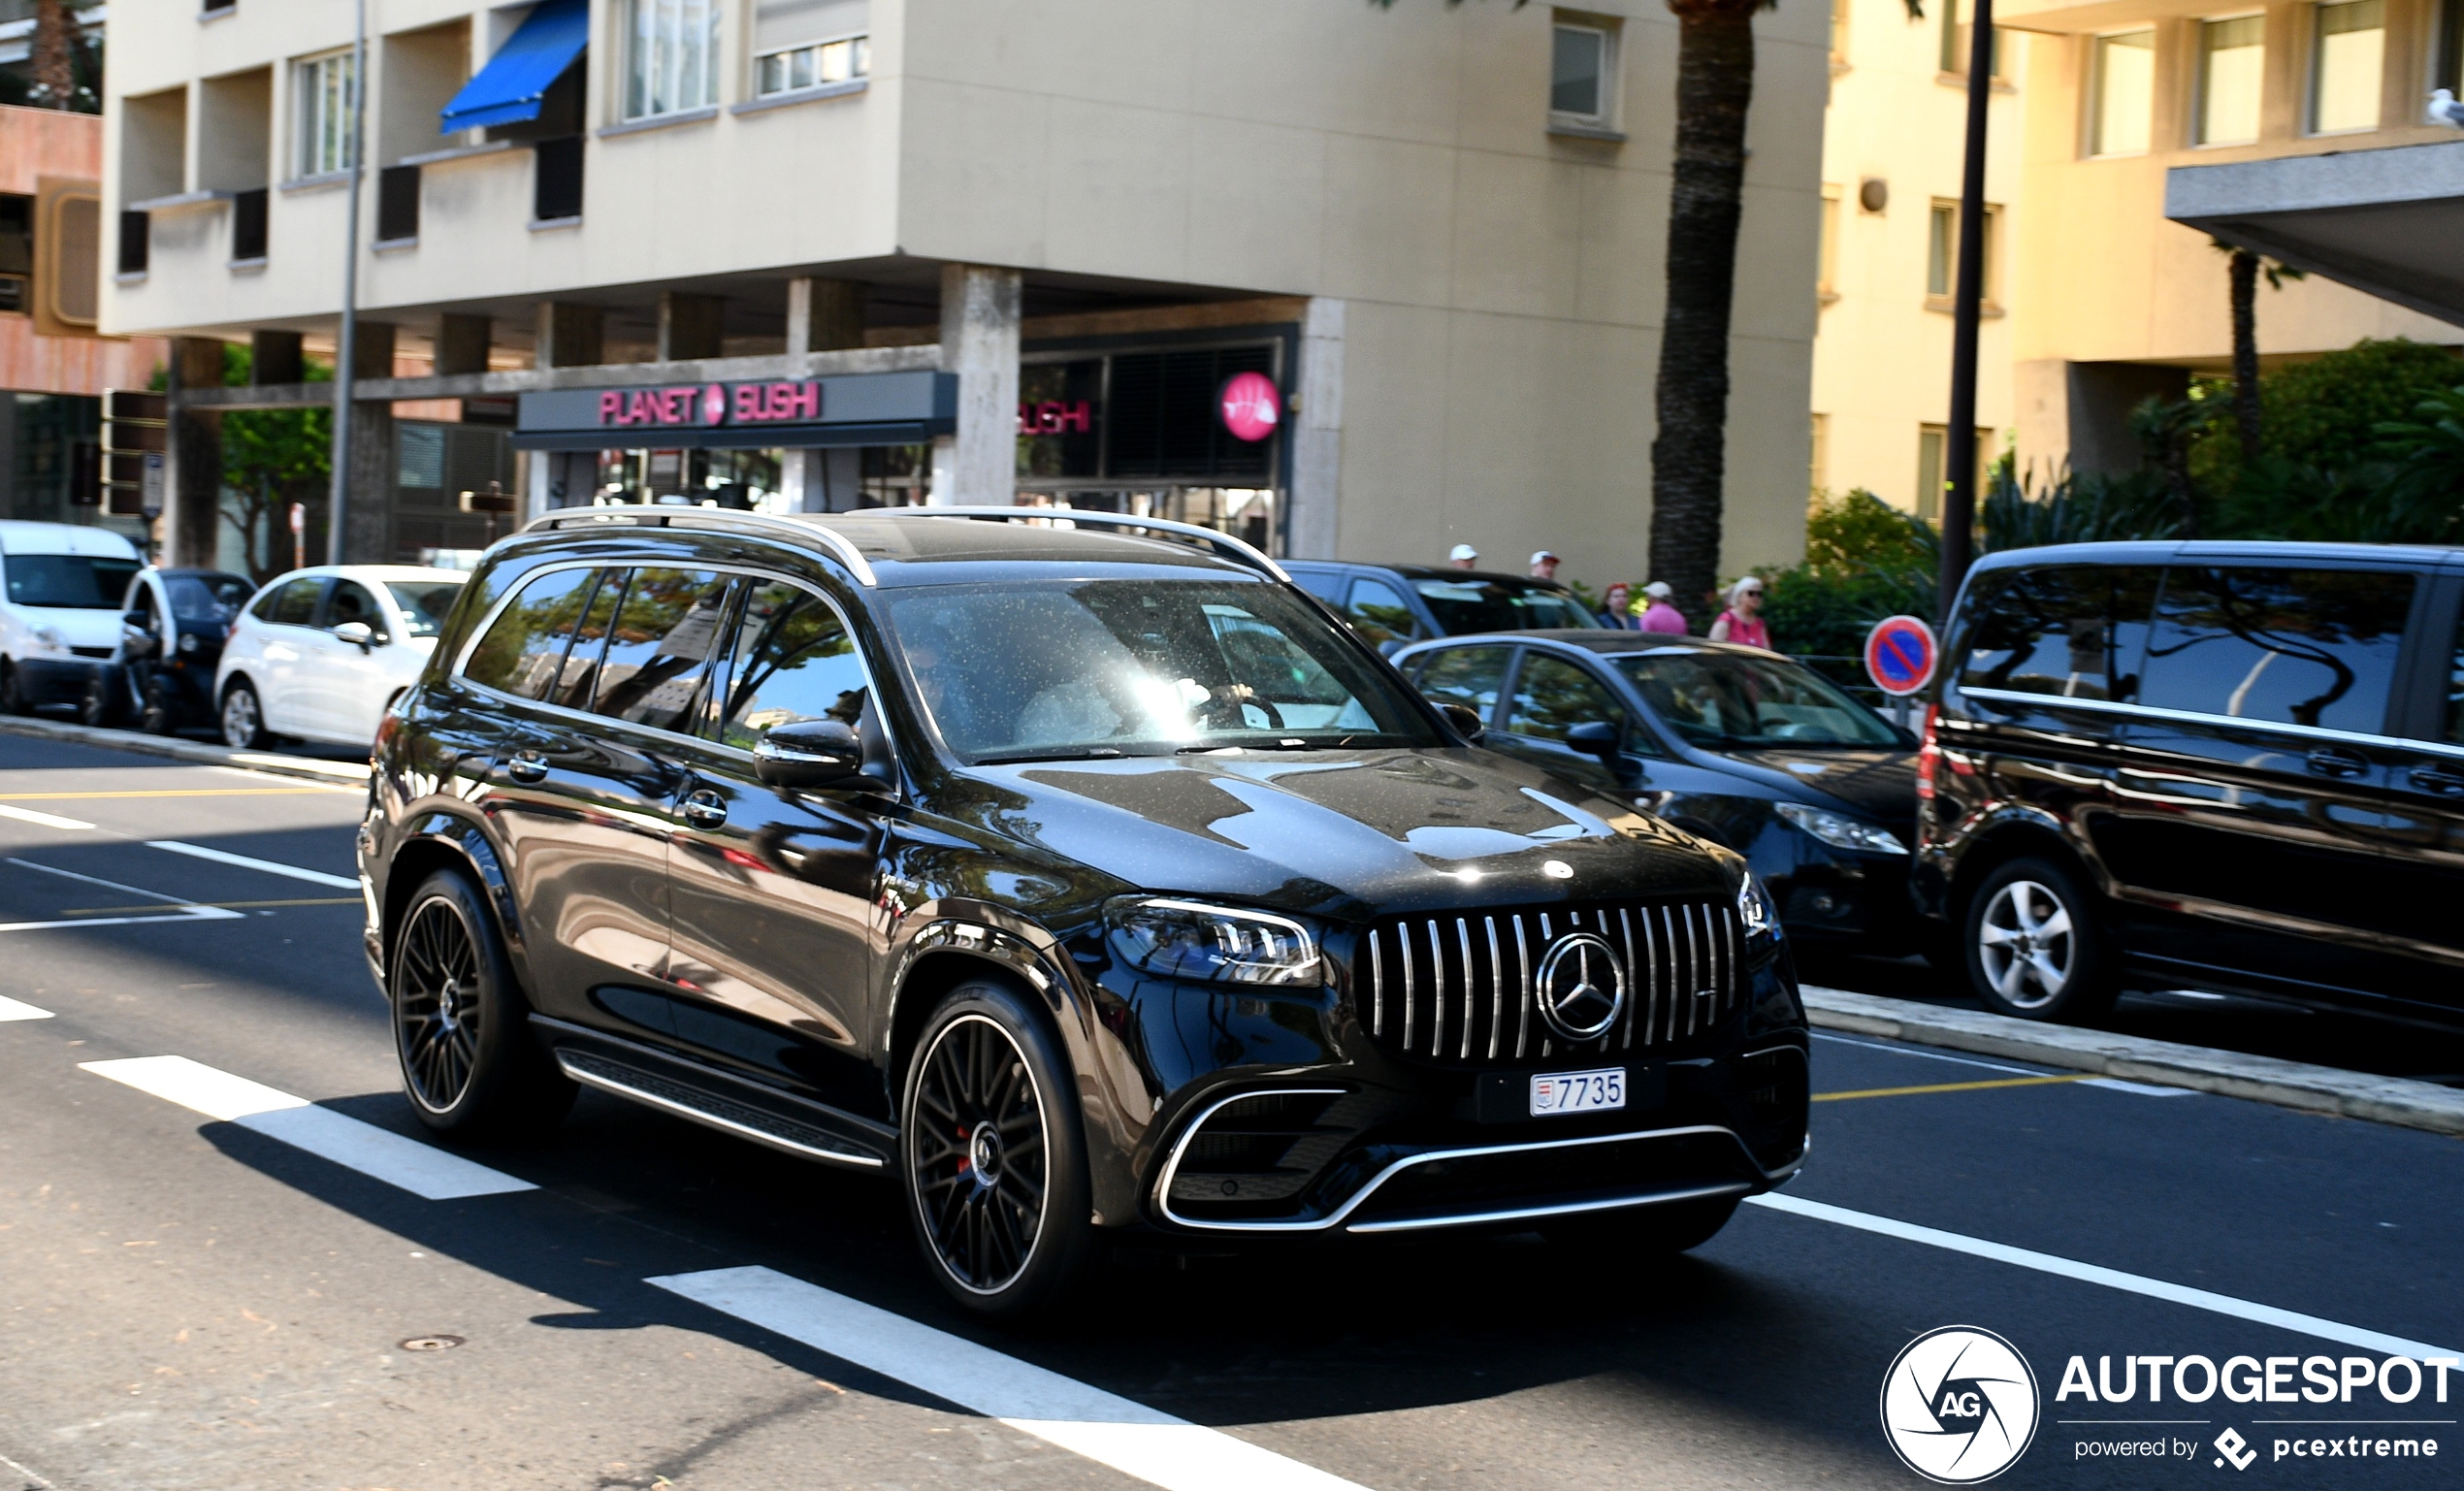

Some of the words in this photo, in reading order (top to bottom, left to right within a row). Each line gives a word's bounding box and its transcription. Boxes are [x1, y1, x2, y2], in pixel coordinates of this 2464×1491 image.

[600, 387, 698, 425] PLANET
[733, 381, 821, 421] SUSHI
[1015, 401, 1090, 434] USHI
[1558, 1074, 1621, 1109] 7735
